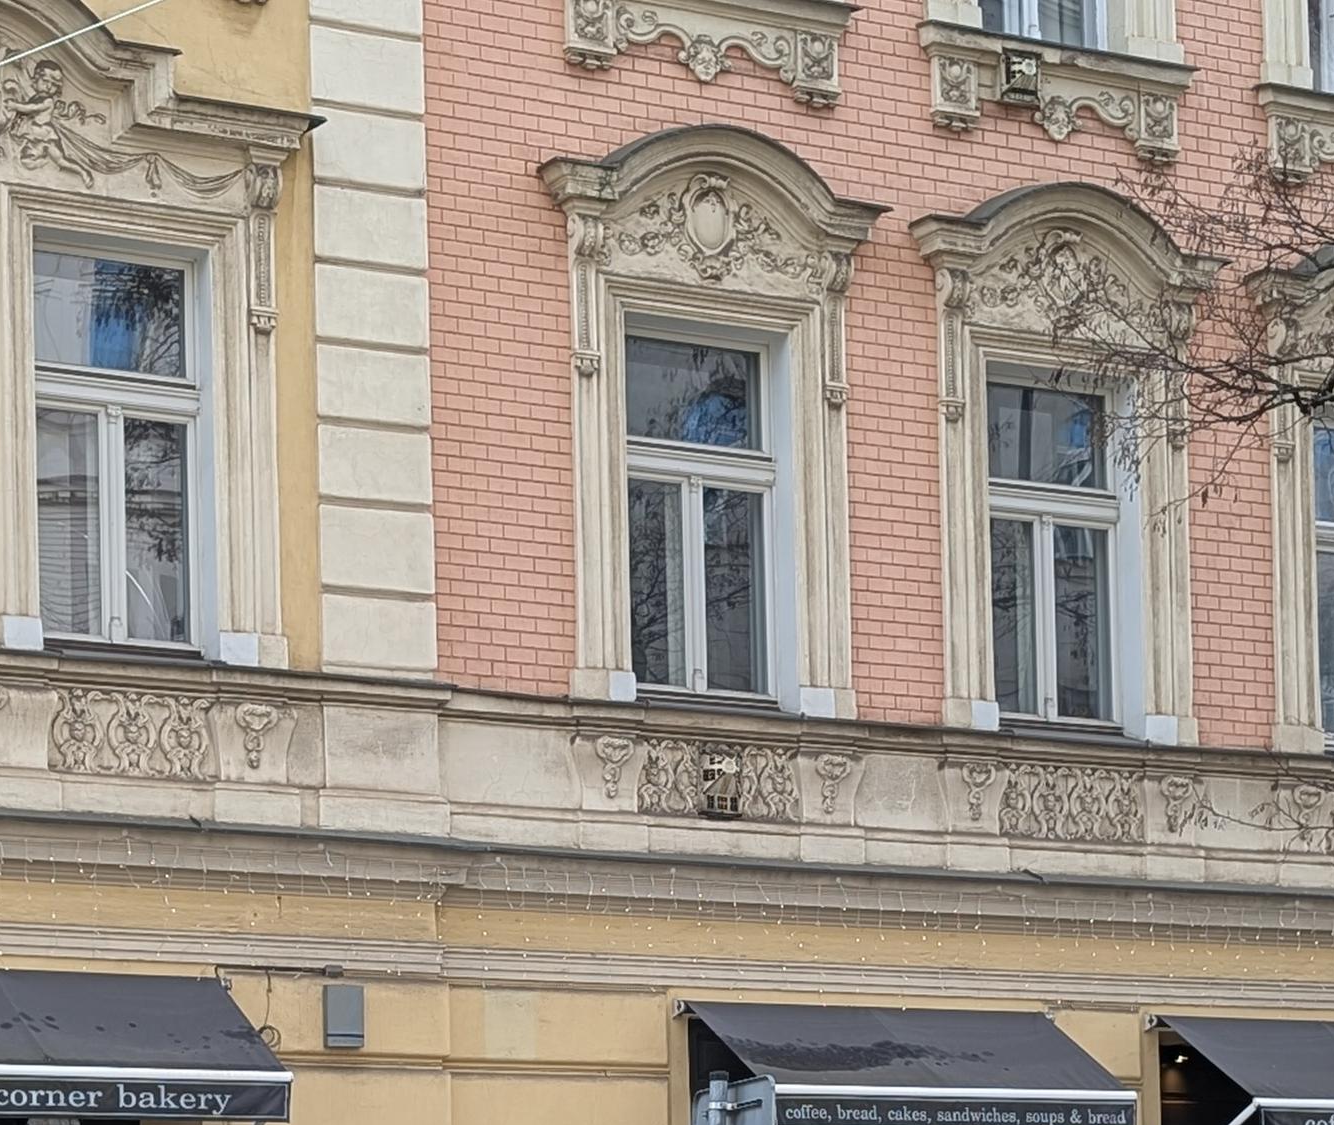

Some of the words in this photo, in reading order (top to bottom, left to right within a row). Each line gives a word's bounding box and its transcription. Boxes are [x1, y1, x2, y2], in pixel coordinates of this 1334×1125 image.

[117, 1084, 233, 1115] bakery
[785, 1104, 832, 1123] coffee,
[837, 1104, 883, 1124] bread,
[887, 1106, 932, 1125] cakes,
[937, 1107, 1020, 1125] sandwiches,
[1070, 1109, 1083, 1124] &
[1087, 1108, 1127, 1125] bread
